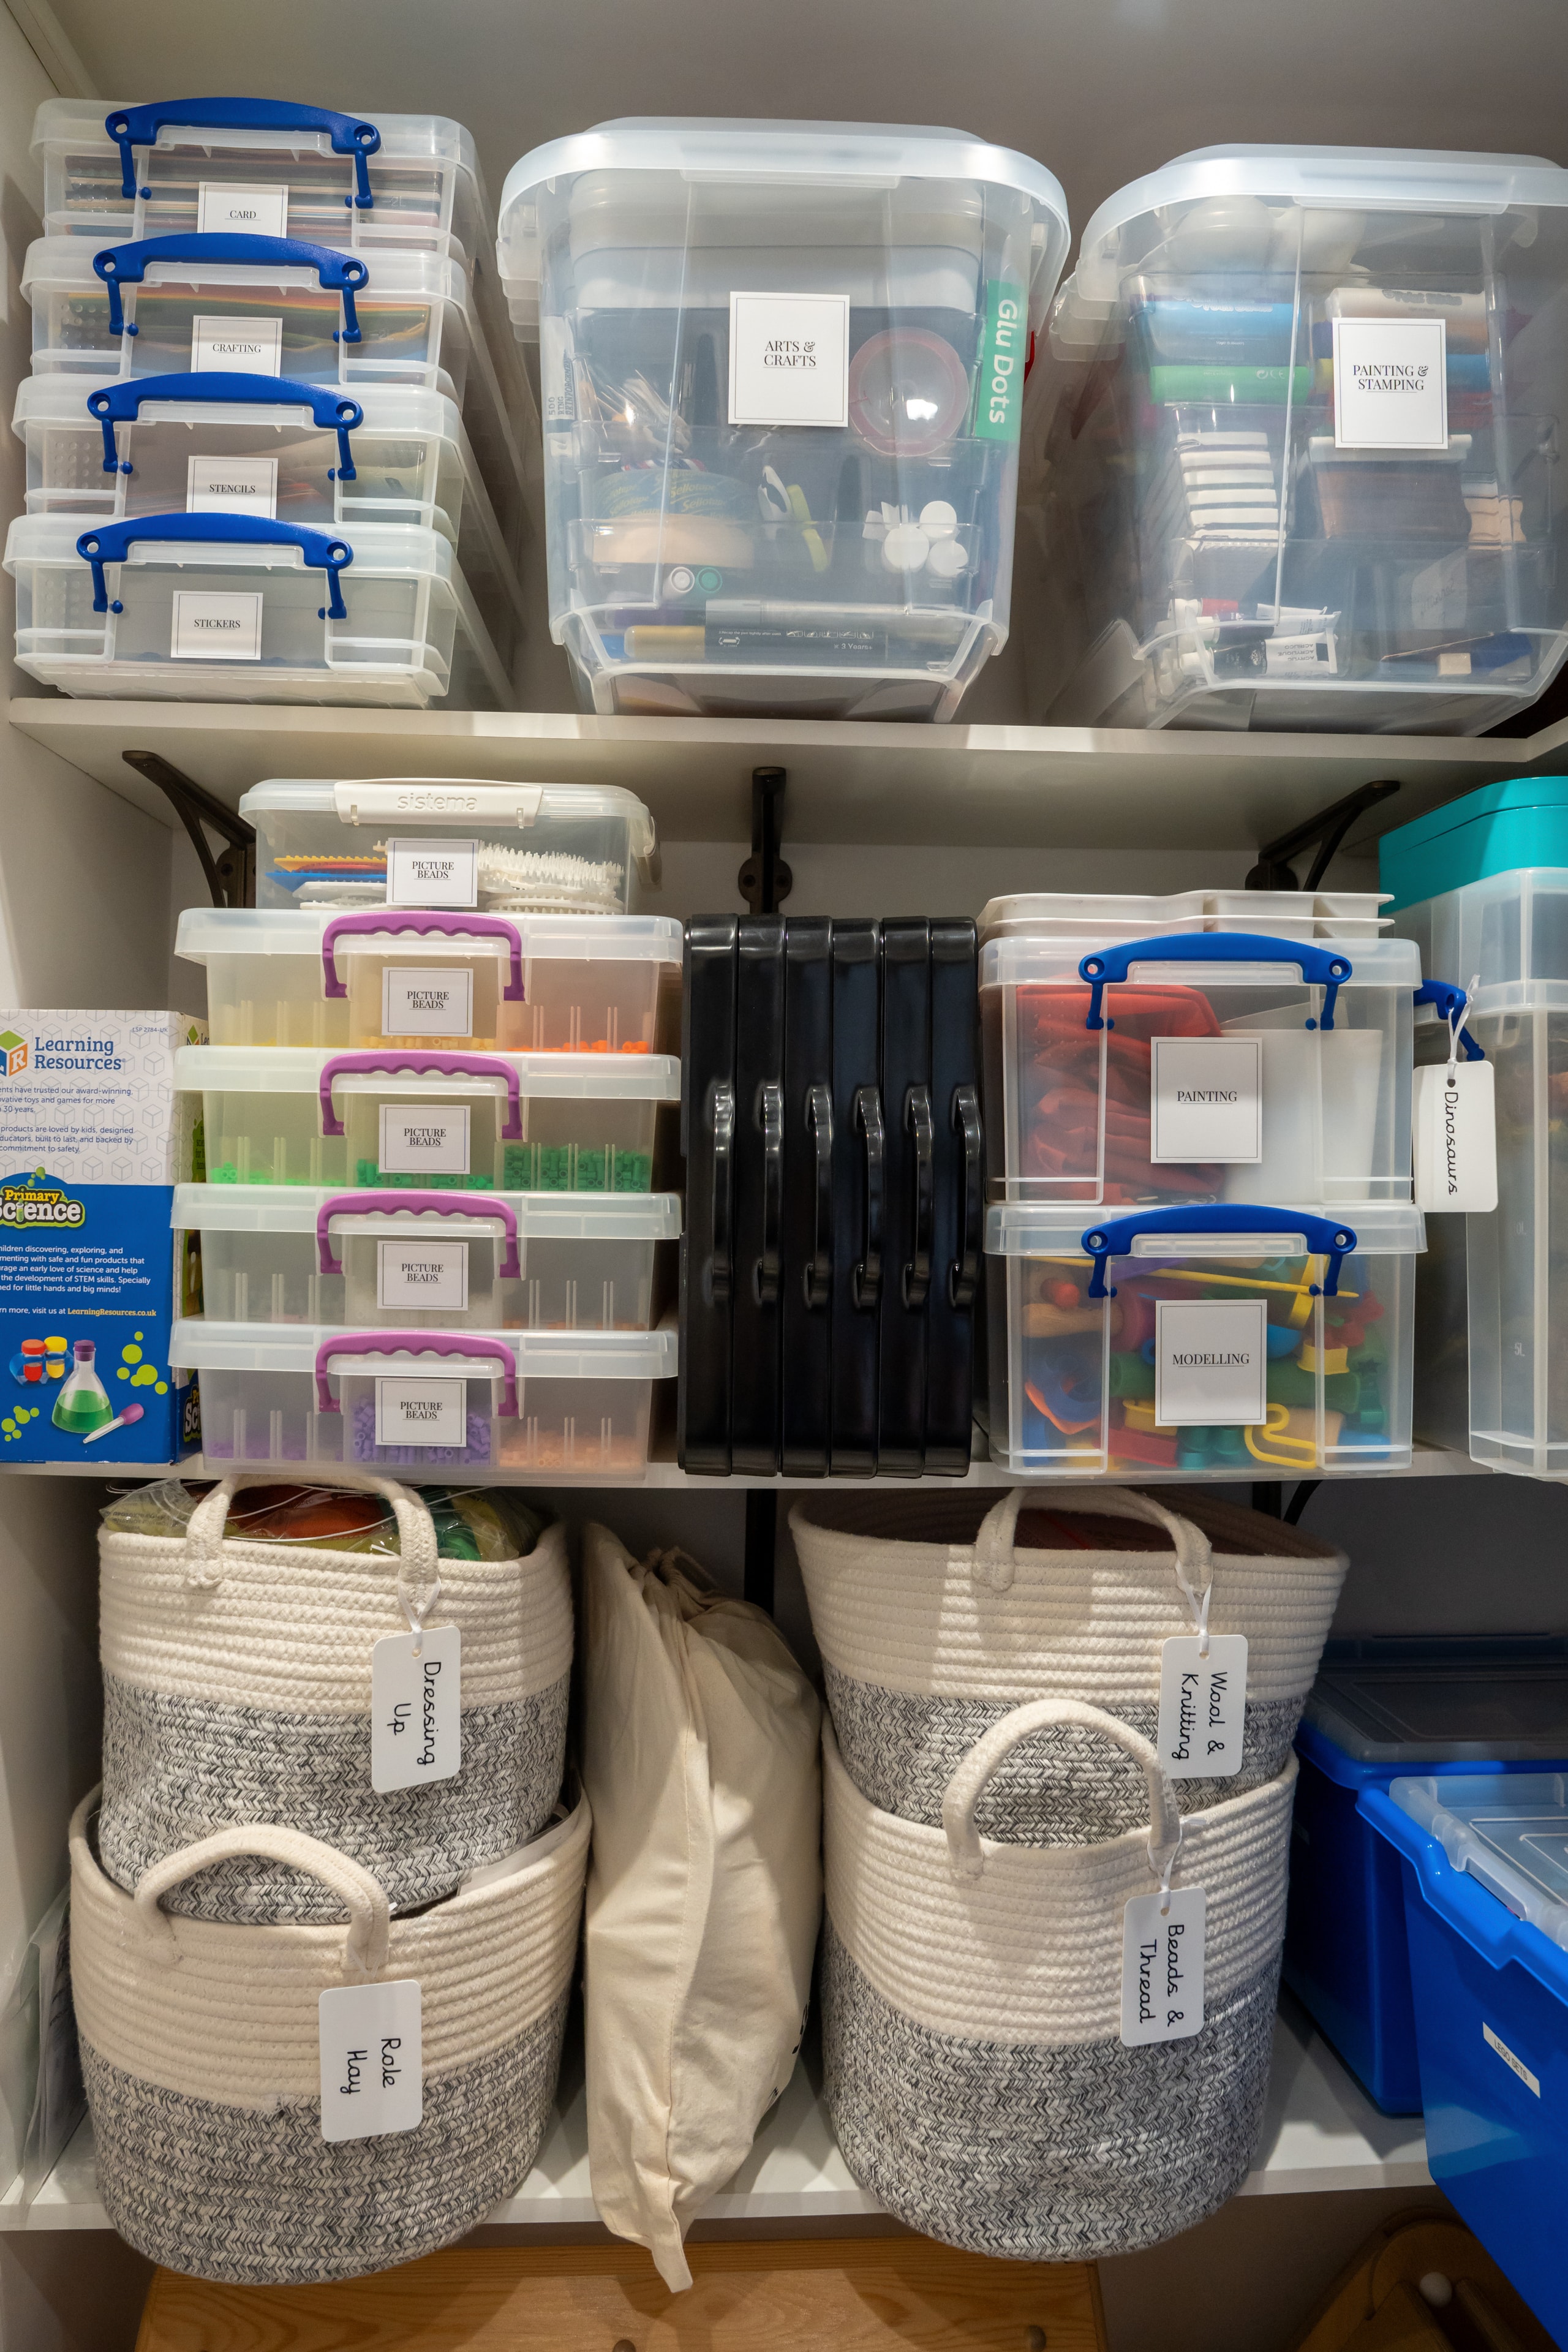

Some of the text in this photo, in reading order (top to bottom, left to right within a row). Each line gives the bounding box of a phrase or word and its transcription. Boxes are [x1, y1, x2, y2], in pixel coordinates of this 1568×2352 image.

[213, 344, 261, 353] CRAFTING
[764, 341, 815, 352] ARTS &
[764, 355, 816, 366] CRAFTS
[989, 299, 1018, 424] Glu Dots
[1353, 364, 1429, 377] PAINTING &
[1358, 379, 1424, 390] STAMPING
[209, 484, 255, 493] STENCILS
[194, 619, 241, 628] STICKERS
[397, 793, 478, 812] sistema
[413, 861, 453, 870] PICTURE
[418, 870, 449, 878] BEADS
[407, 991, 449, 1000] PICTURE
[413, 1000, 445, 1009] BEADS
[34, 1036, 115, 1056] Learning
[75, 1087, 134, 1096] award-winning,
[1177, 1090, 1238, 1102] PAINTING
[24, 1096, 39, 1105] toys
[1, 1125, 34, 1134] products
[81, 1126, 99, 1134] kids,
[99, 1126, 134, 1136] designed
[404, 1128, 447, 1137] PICTURE
[409, 1136, 442, 1146] BEADS
[1444, 1091, 1458, 1196] Dinosaurs
[57, 1145, 81, 1155] safety.
[5, 1189, 60, 1204] Primary
[0, 1197, 81, 1223] cience
[24, 1245, 69, 1254] discovering,
[70, 1246, 108, 1256] exploring,
[94, 1257, 129, 1265] products
[29, 1265, 48, 1274] early
[121, 1267, 138, 1276] help
[401, 1263, 443, 1273] PICTURE
[14, 1275, 64, 1284] development
[118, 1276, 151, 1286] Specially
[407, 1272, 439, 1282] BEADS
[83, 1285, 95, 1295] big
[67, 1308, 157, 1317] LearningResources.co.uk
[1172, 1352, 1250, 1365] MODELLING
[400, 1401, 443, 1411] PICTURE
[405, 1409, 438, 1419] BEADS
[417, 1661, 442, 1765] Dressing
[1171, 1673, 1199, 1760] Knitting
[1207, 1672, 1227, 1755] Wool &
[386, 1703, 412, 1736] Up
[1139, 1938, 1157, 2024] Thread
[1167, 1924, 1185, 2027] Beads &
[381, 2038, 402, 2089] Role
[1494, 2038, 1528, 2081] LEGO SETS
[339, 2049, 368, 2095] Hay
